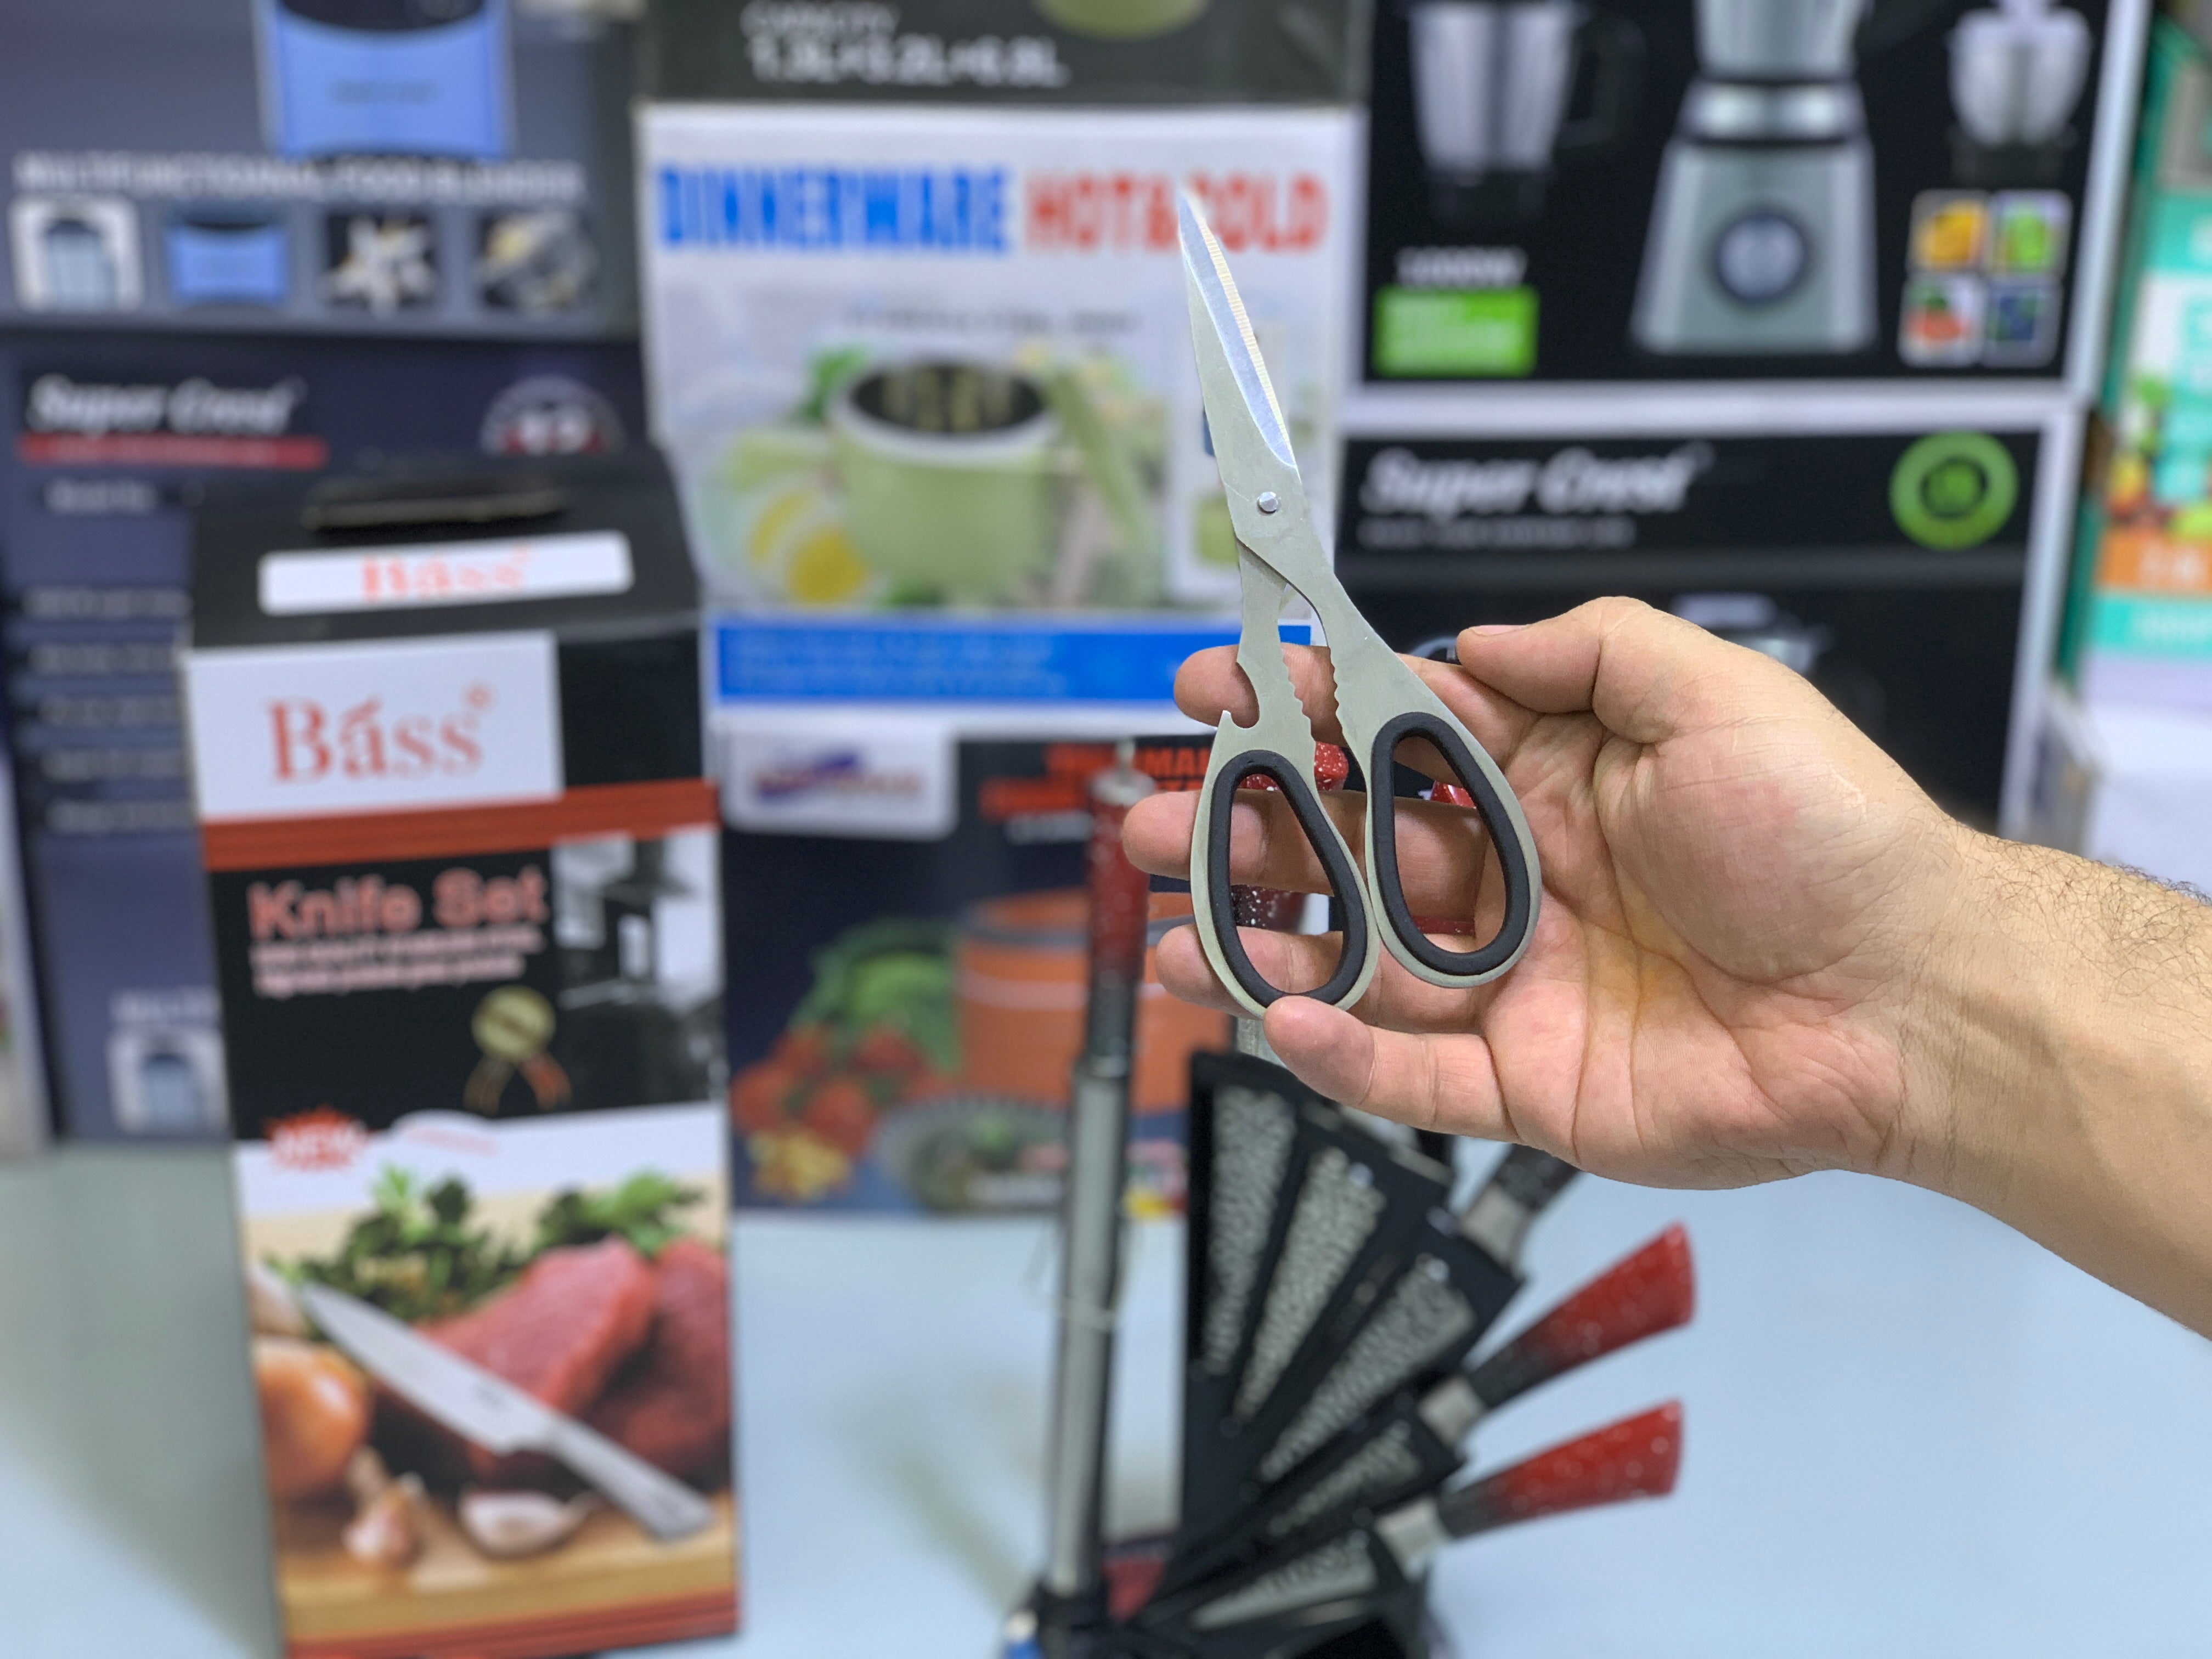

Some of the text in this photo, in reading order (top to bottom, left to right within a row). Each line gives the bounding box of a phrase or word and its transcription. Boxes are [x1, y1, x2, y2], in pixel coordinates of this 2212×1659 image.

[658, 165, 1011, 253] DINNERWARE
[1361, 446, 1696, 522] Super Crest
[269, 695, 484, 785] Báss
[246, 866, 551, 941] Knife Set
